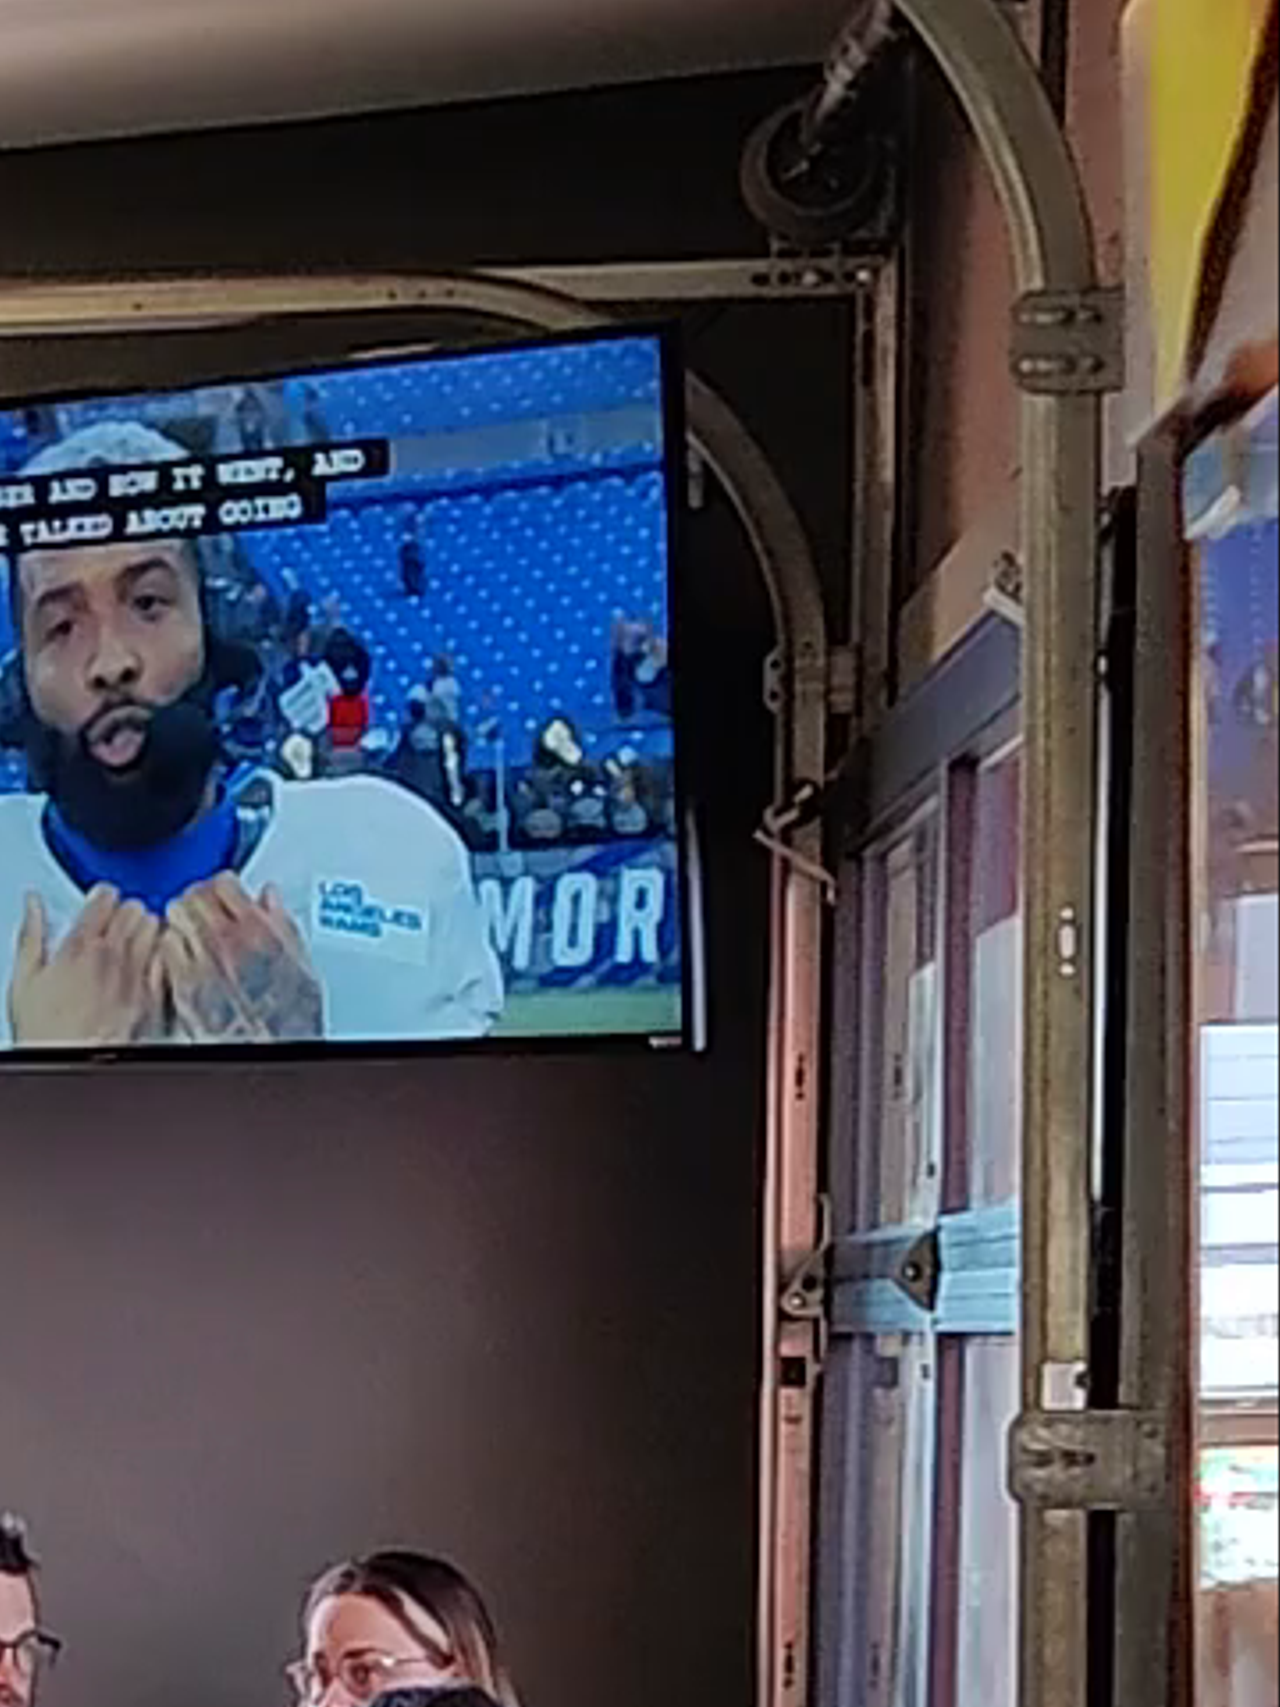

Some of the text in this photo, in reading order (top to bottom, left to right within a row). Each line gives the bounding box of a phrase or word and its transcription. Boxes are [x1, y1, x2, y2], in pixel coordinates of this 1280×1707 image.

[48, 478, 97, 504] AND
[171, 464, 205, 491] IT
[311, 449, 365, 477] AND
[19, 514, 113, 547] TALKED
[124, 504, 206, 534] ABOUT
[218, 493, 302, 525] GOING
